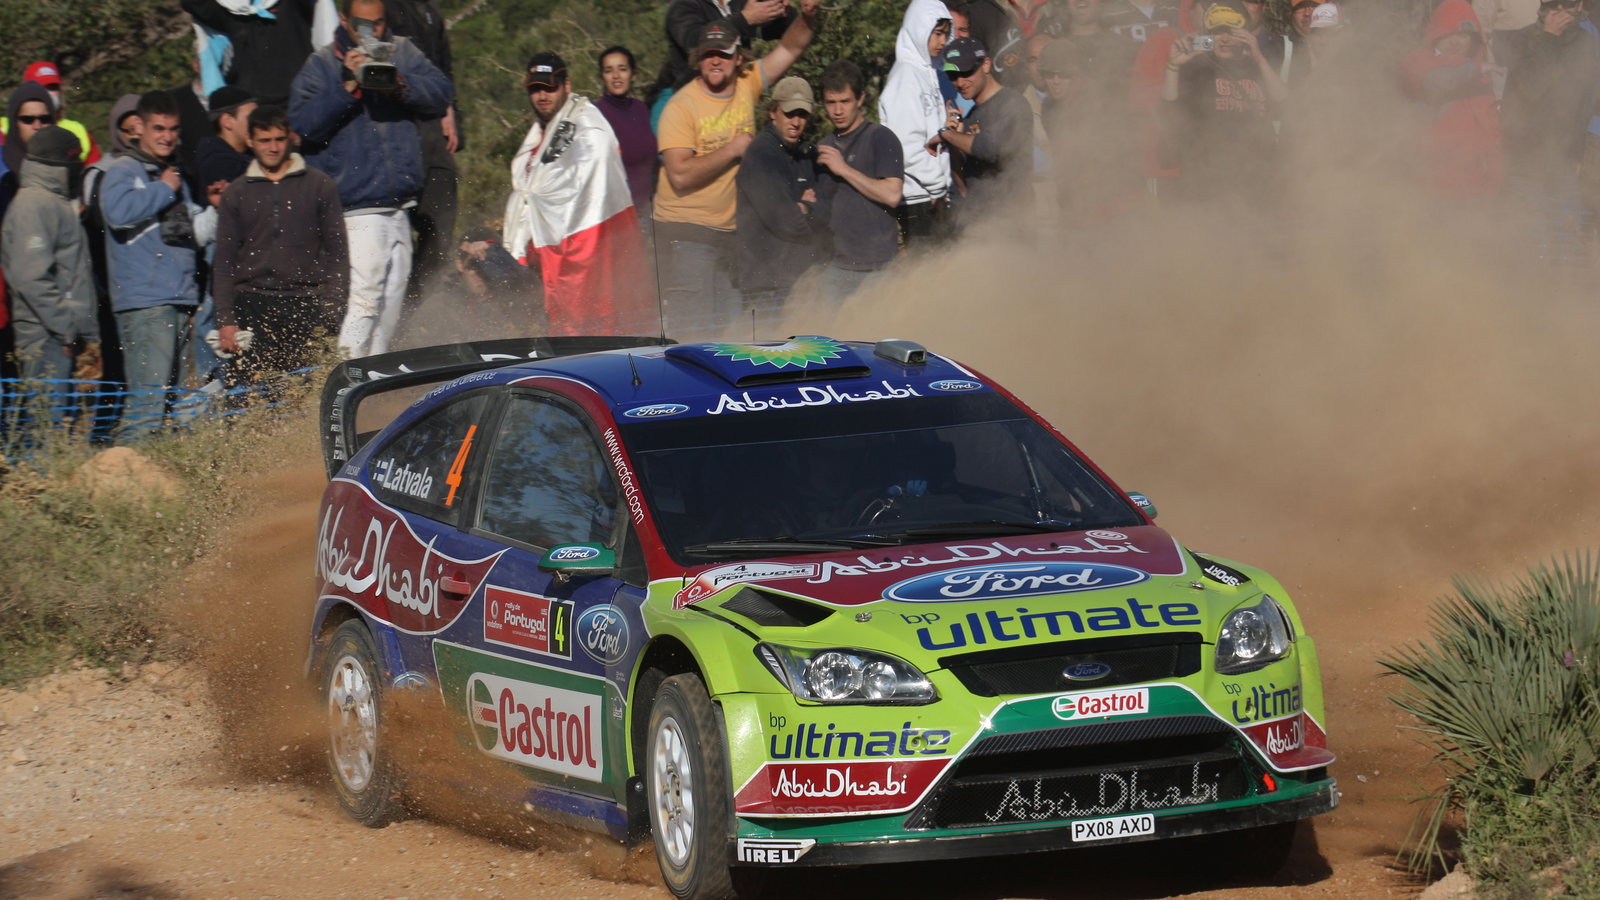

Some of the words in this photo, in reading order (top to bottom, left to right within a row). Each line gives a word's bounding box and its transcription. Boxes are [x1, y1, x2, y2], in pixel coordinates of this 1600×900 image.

[940, 381, 974, 390] Ford
[637, 405, 677, 416] Ford
[445, 424, 478, 506] 4
[604, 427, 645, 524] www.wrcford.com
[382, 457, 433, 498] Latvala
[558, 547, 590, 559] Ford
[939, 565, 1102, 599] Ford
[504, 610, 546, 633] Portugal
[555, 606, 565, 652] 4
[900, 610, 941, 625] bp
[916, 598, 1201, 651] ultimate
[587, 612, 622, 656] Ford
[1074, 663, 1101, 676] Ford
[1222, 682, 1242, 696] bp
[1077, 691, 1145, 715] Castrol
[500, 687, 597, 768] Castrol
[770, 712, 787, 731] bp
[770, 721, 951, 759] ultimate
[1075, 821, 1114, 838] PX08
[1119, 816, 1152, 834] AXD
